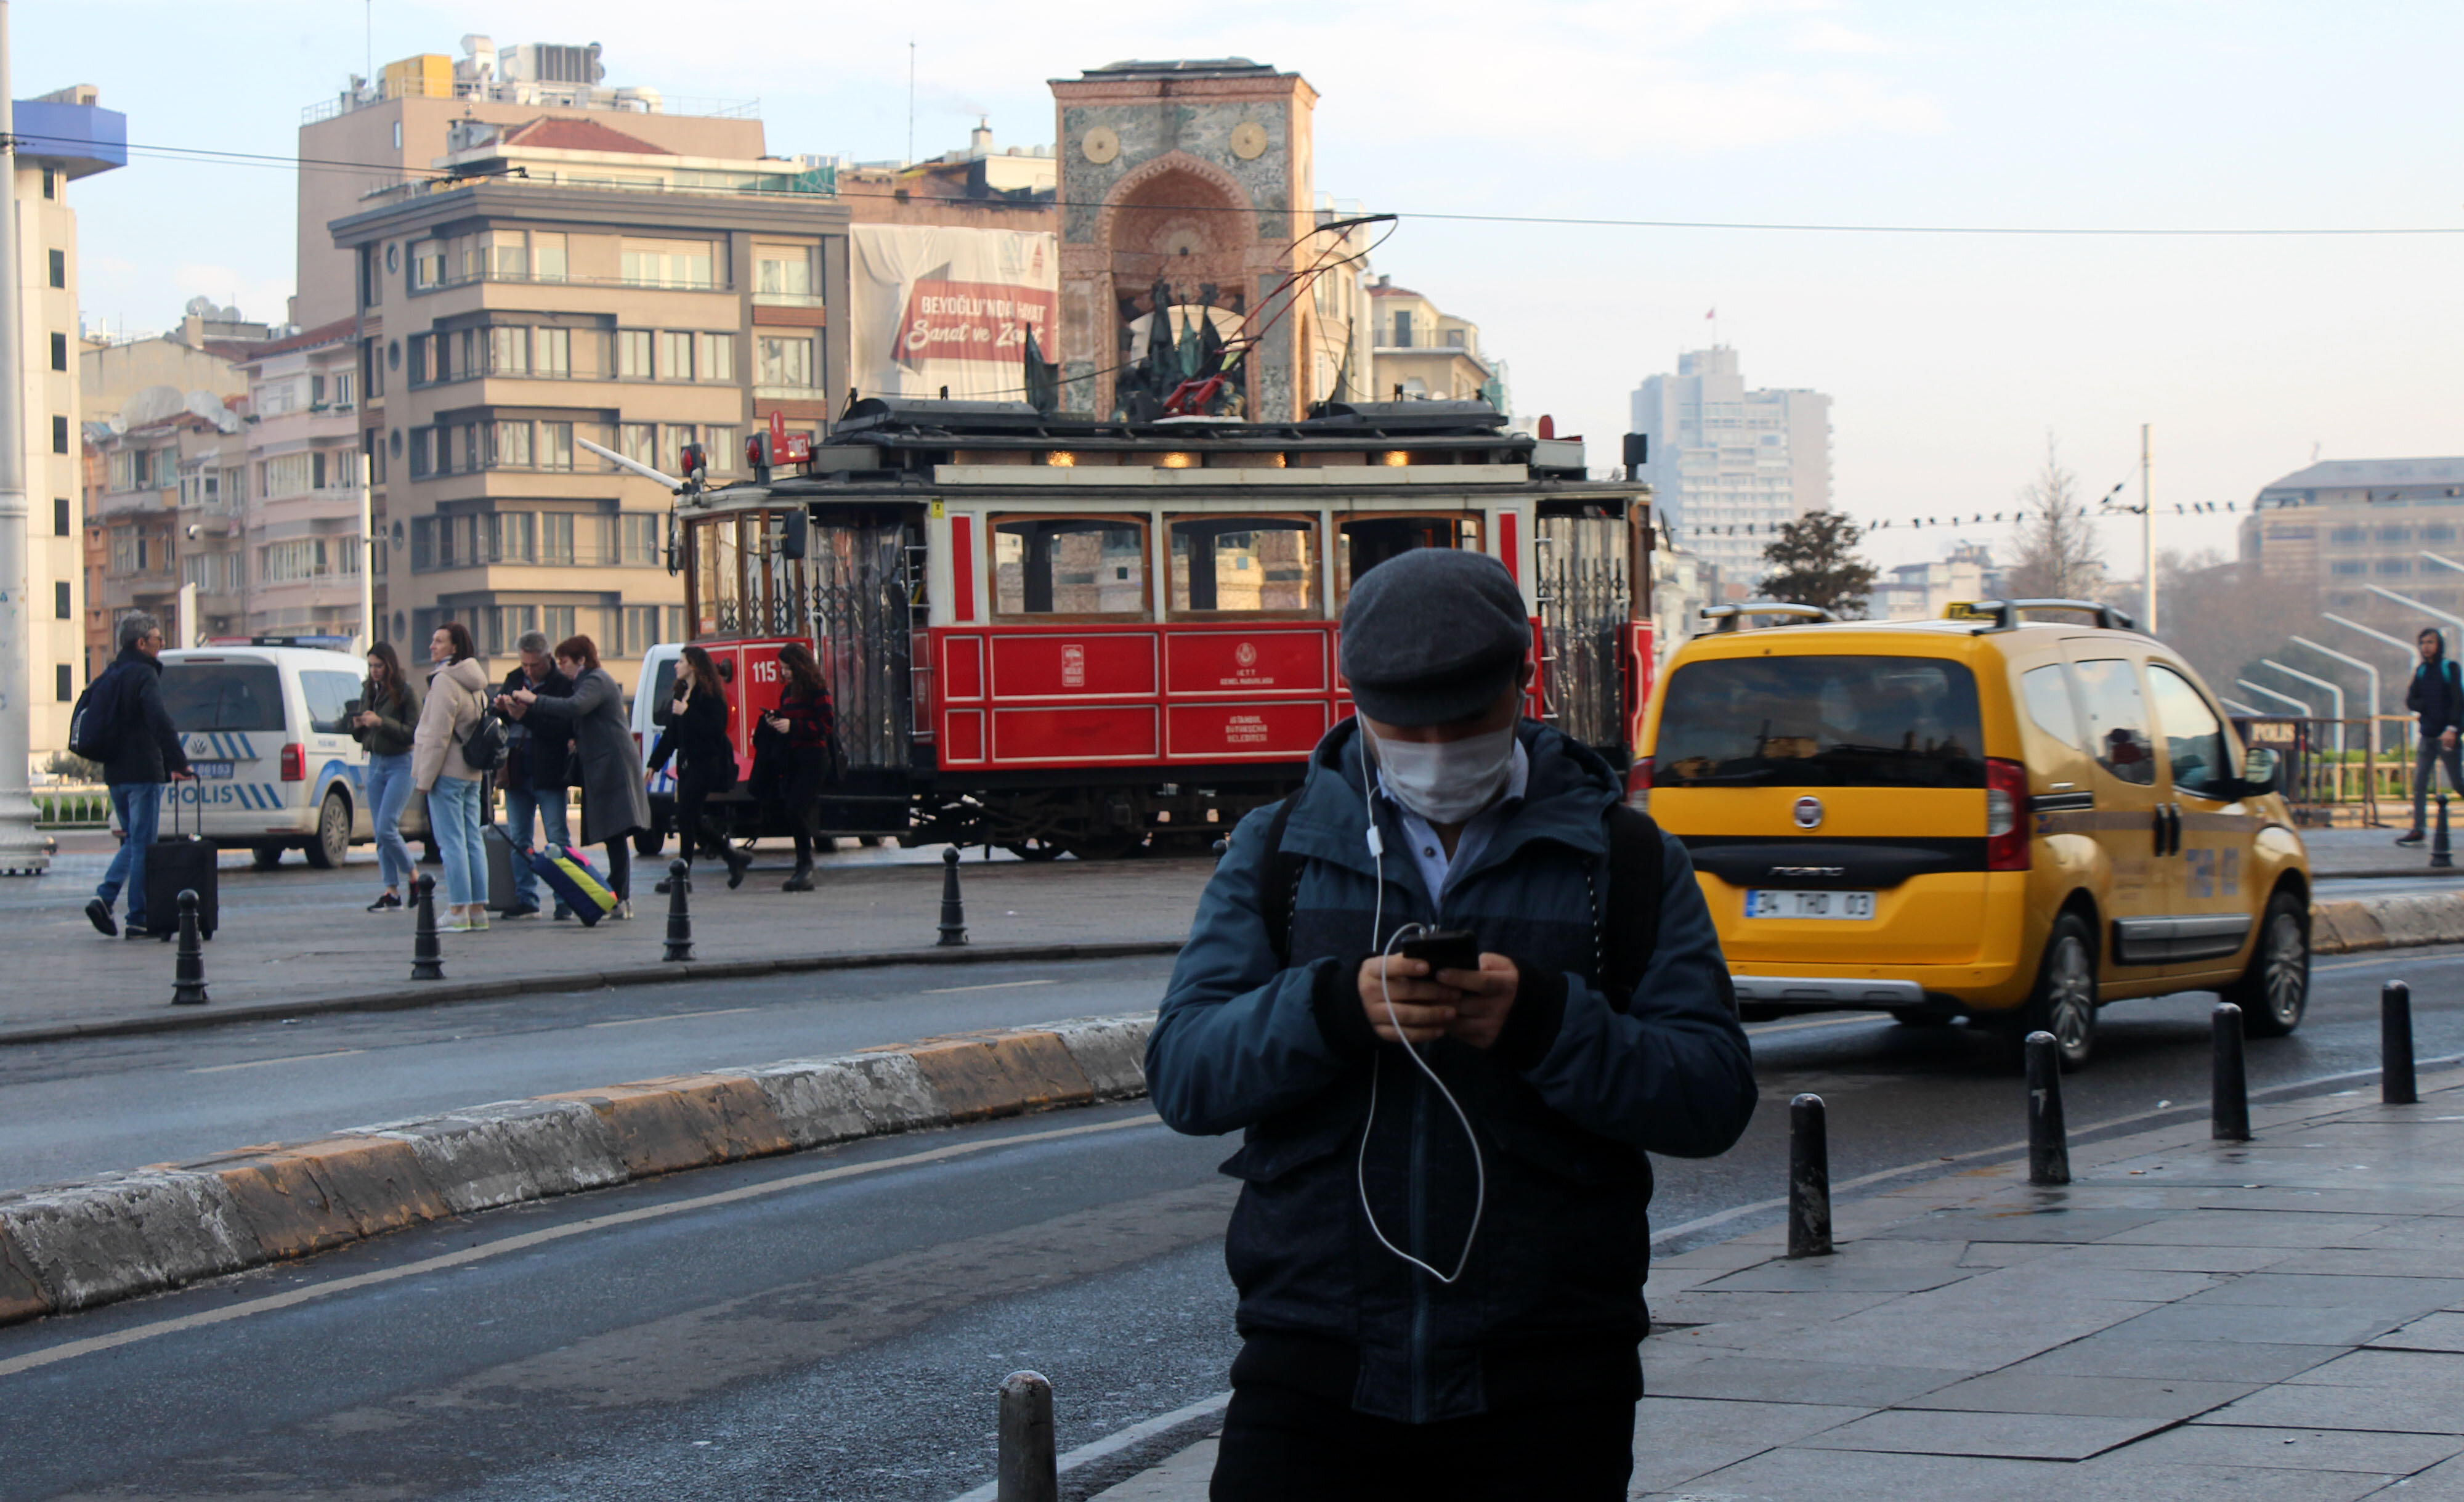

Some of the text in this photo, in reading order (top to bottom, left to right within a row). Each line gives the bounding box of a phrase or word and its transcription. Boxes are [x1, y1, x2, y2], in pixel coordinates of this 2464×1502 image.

[922, 294, 1014, 319] BEYOĞLU'NDA
[905, 319, 971, 351] Sanat
[973, 327, 991, 343] ve
[752, 660, 777, 683] 115
